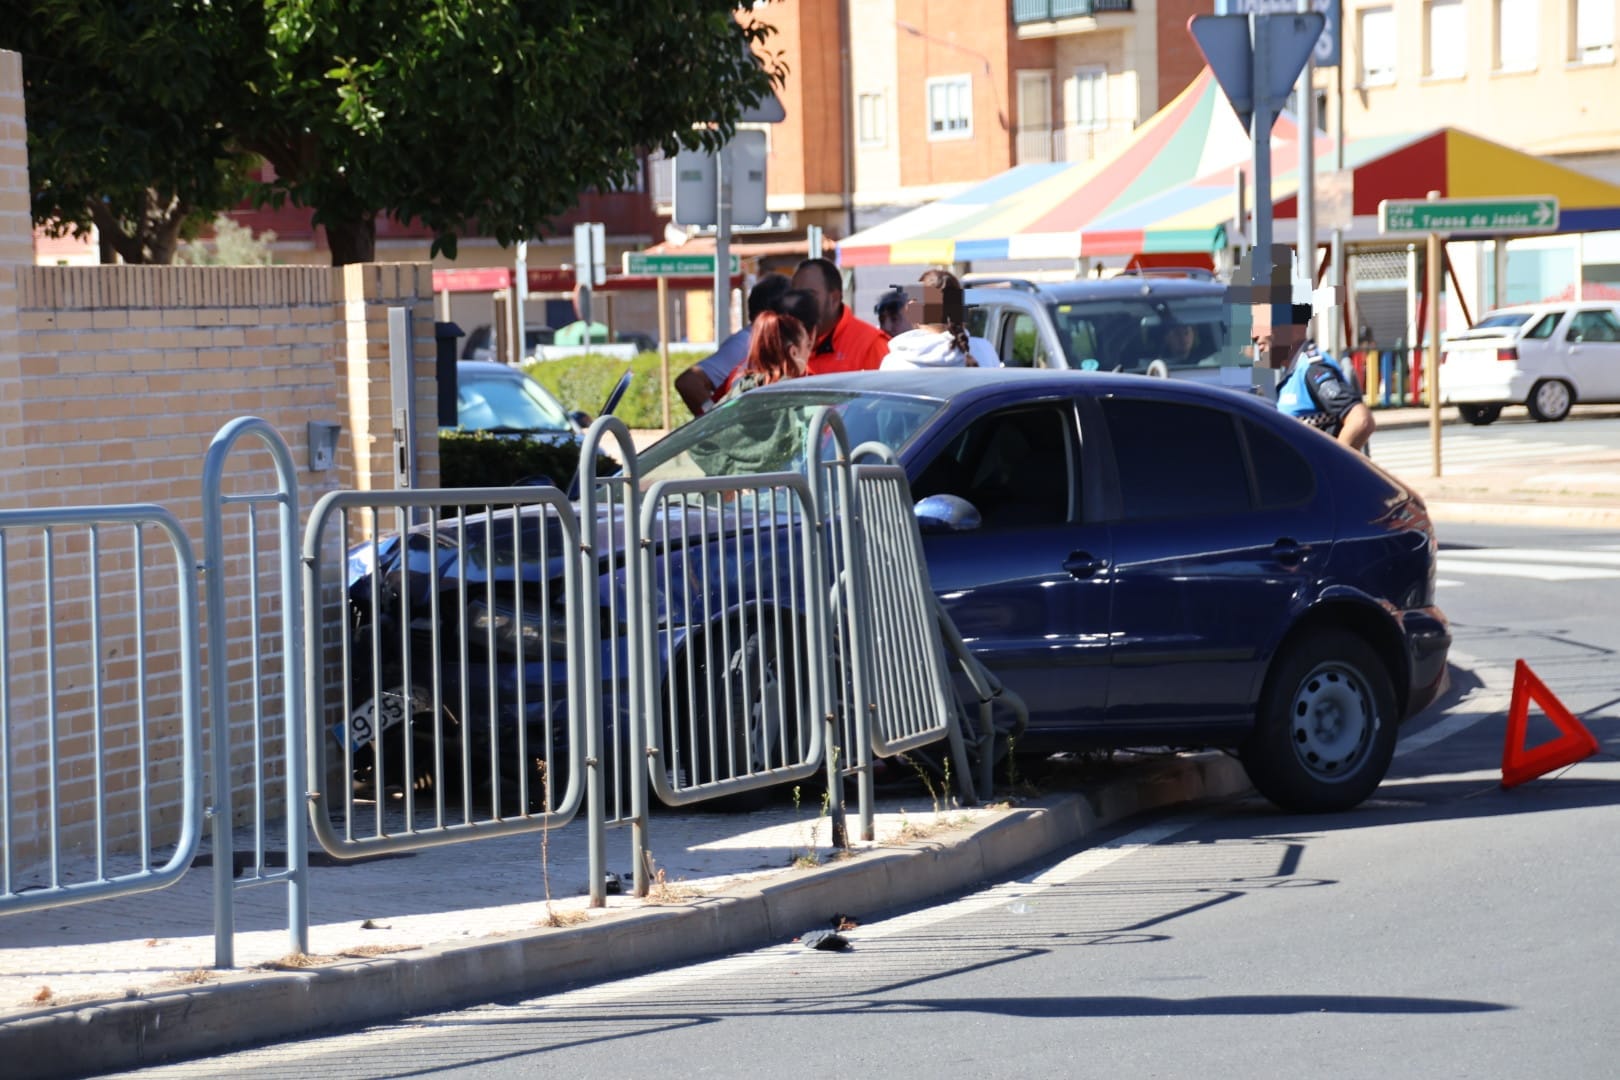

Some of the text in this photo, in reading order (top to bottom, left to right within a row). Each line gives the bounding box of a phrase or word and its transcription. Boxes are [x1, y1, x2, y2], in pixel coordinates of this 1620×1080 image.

[1390, 215, 1418, 229] Sta.
[1423, 214, 1467, 227] Teresa
[1470, 212, 1488, 226] de
